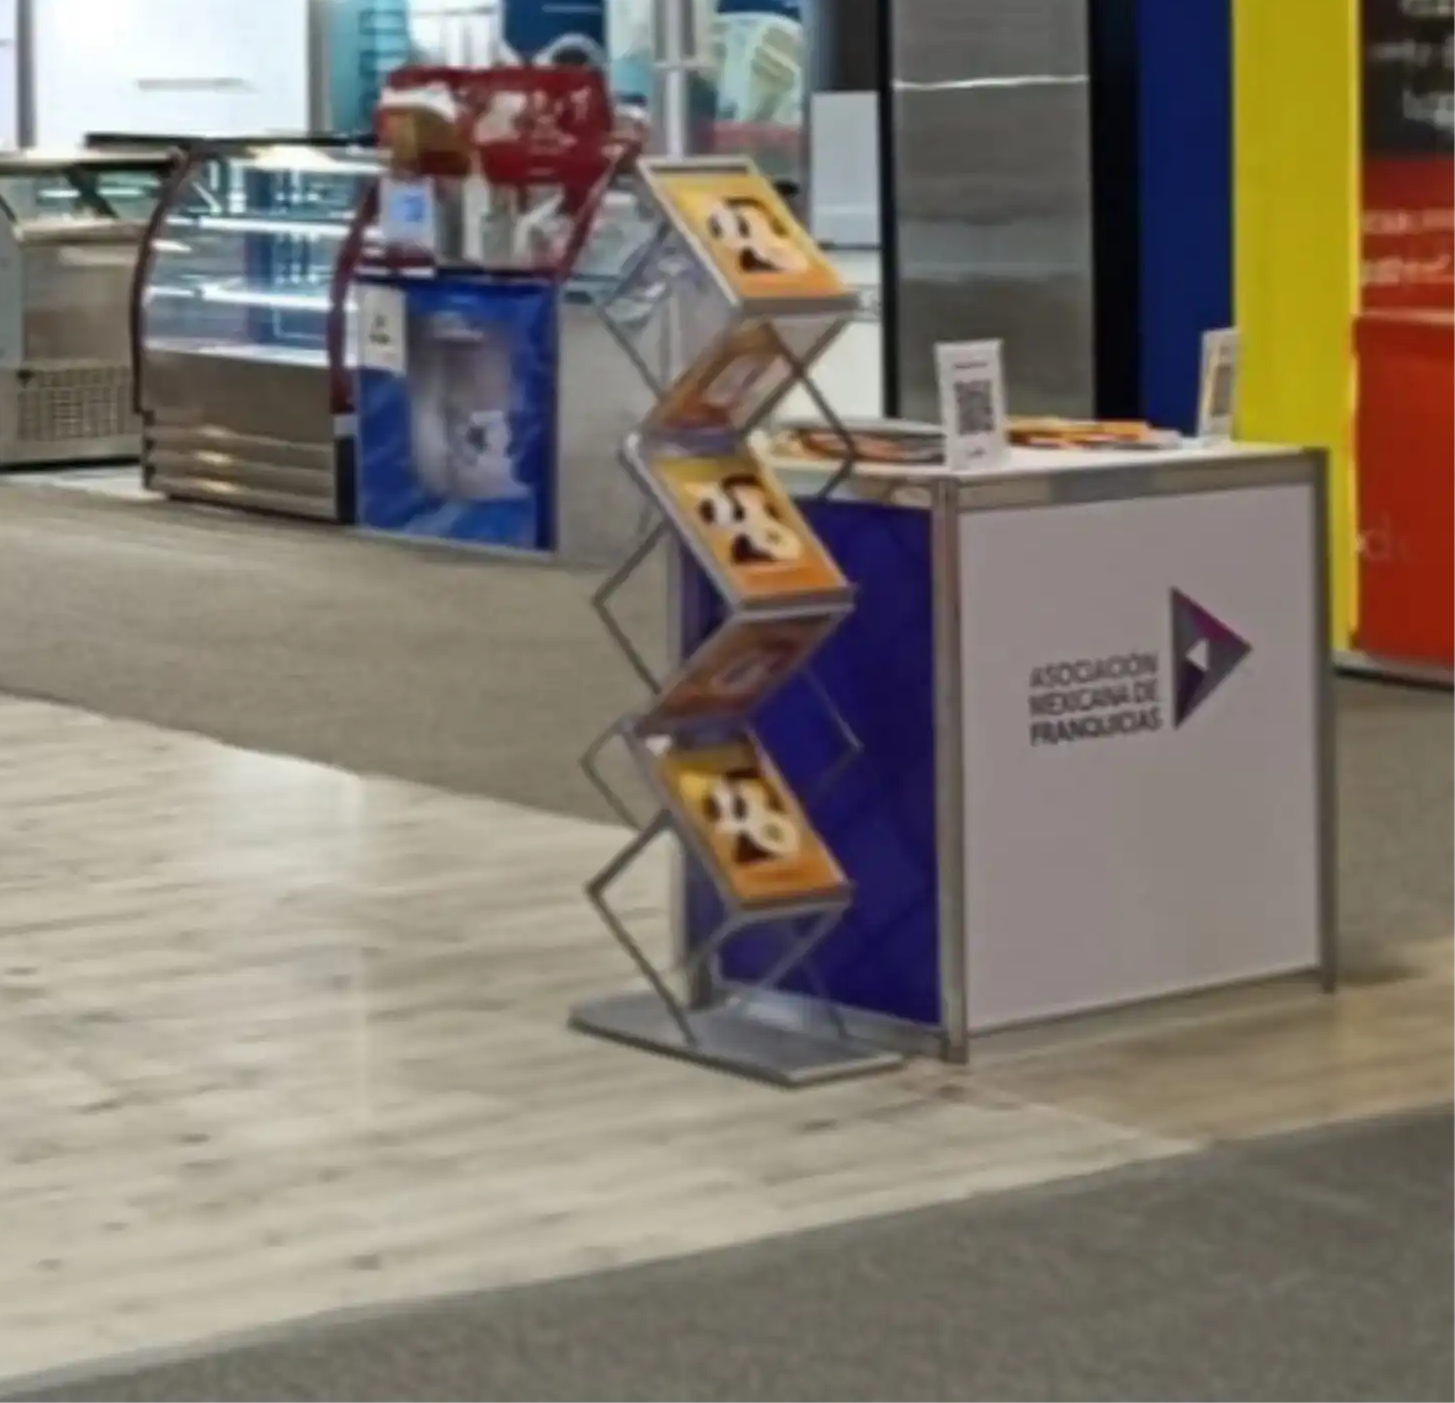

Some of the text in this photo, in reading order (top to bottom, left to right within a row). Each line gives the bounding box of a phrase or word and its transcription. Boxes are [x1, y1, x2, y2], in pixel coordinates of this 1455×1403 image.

[1029, 650, 1160, 689] ASOCIACIÓN
[1028, 677, 1159, 717] MEXICANA DE
[1029, 705, 1164, 748] FRANQUICIAS
